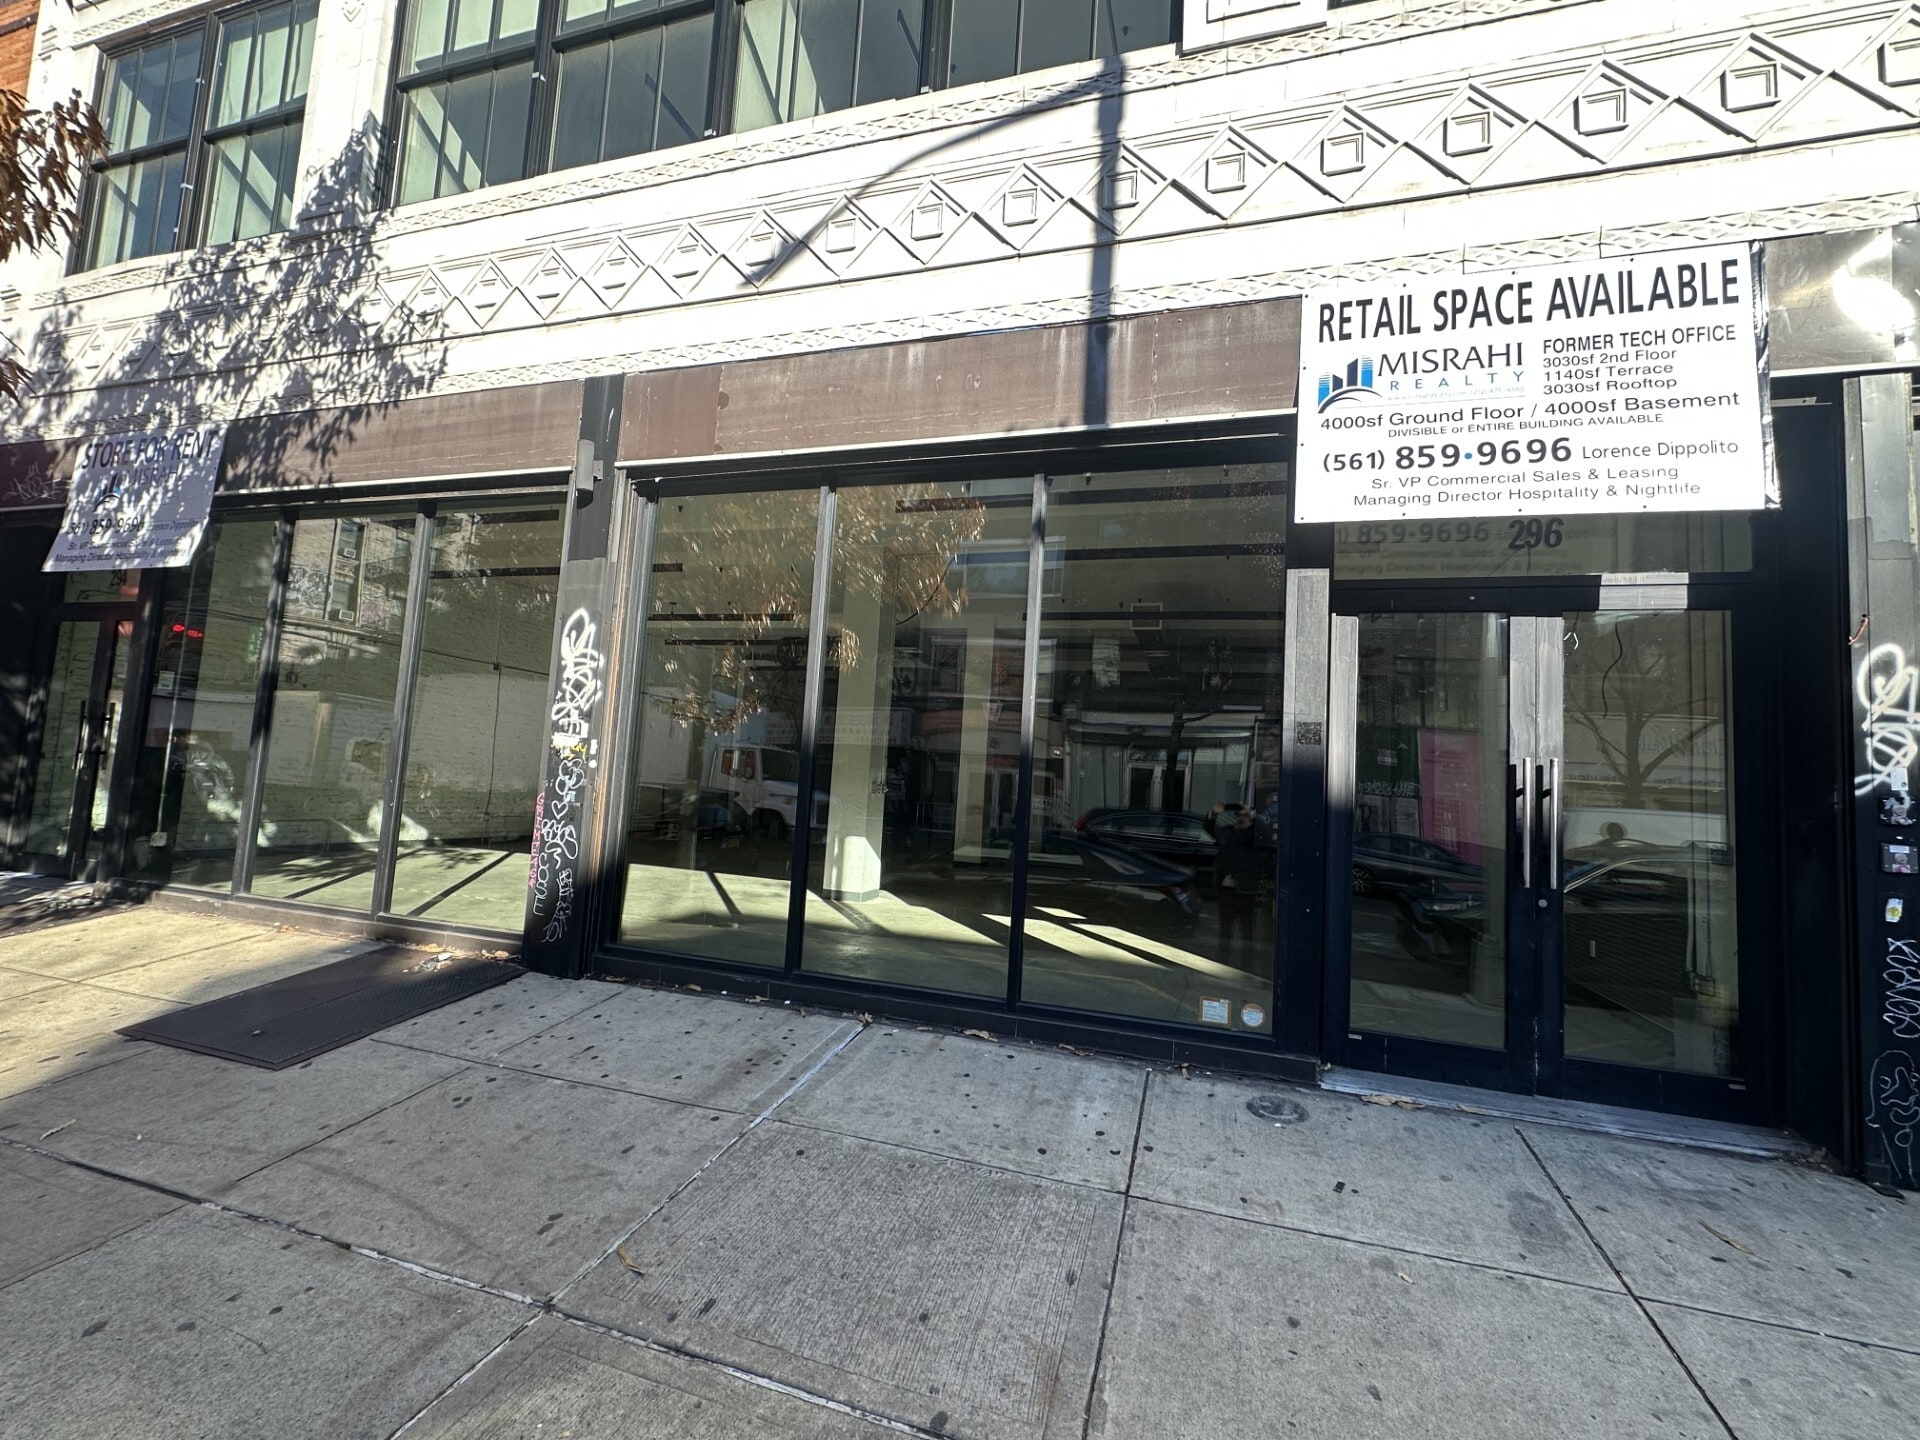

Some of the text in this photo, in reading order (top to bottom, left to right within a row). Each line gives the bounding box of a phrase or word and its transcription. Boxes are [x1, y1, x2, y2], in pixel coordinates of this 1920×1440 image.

[1319, 259, 1739, 343] RETAIL SPACE AVAILABLE
[1543, 324, 1736, 354] FORMER TECH OFFICE
[1377, 342, 1523, 376] MISRAHI
[1543, 349, 1677, 368] 3030sf 2nd Floor
[1390, 371, 1525, 391] REALTY
[1543, 377, 1677, 395] 3030sf Rooftop
[1544, 364, 1673, 381] 1140sf Terrace
[1320, 392, 1740, 430] 4000sf Ground Floor / 4000sf Basement
[1388, 414, 1664, 438] DIVISIBLE or ENTIRE BUILDING AVAILABLE
[82, 430, 219, 469] STORE FOR RENT
[1323, 449, 1385, 472] (561)
[1582, 445, 1651, 459] Lorence
[1658, 440, 1739, 458] Dippolito
[1371, 467, 1679, 489] Sr. VP Commercial Sales & Leasing
[1354, 482, 1701, 507] Managing Director Hospitality & Nightlife
[1508, 517, 1564, 550] 296
